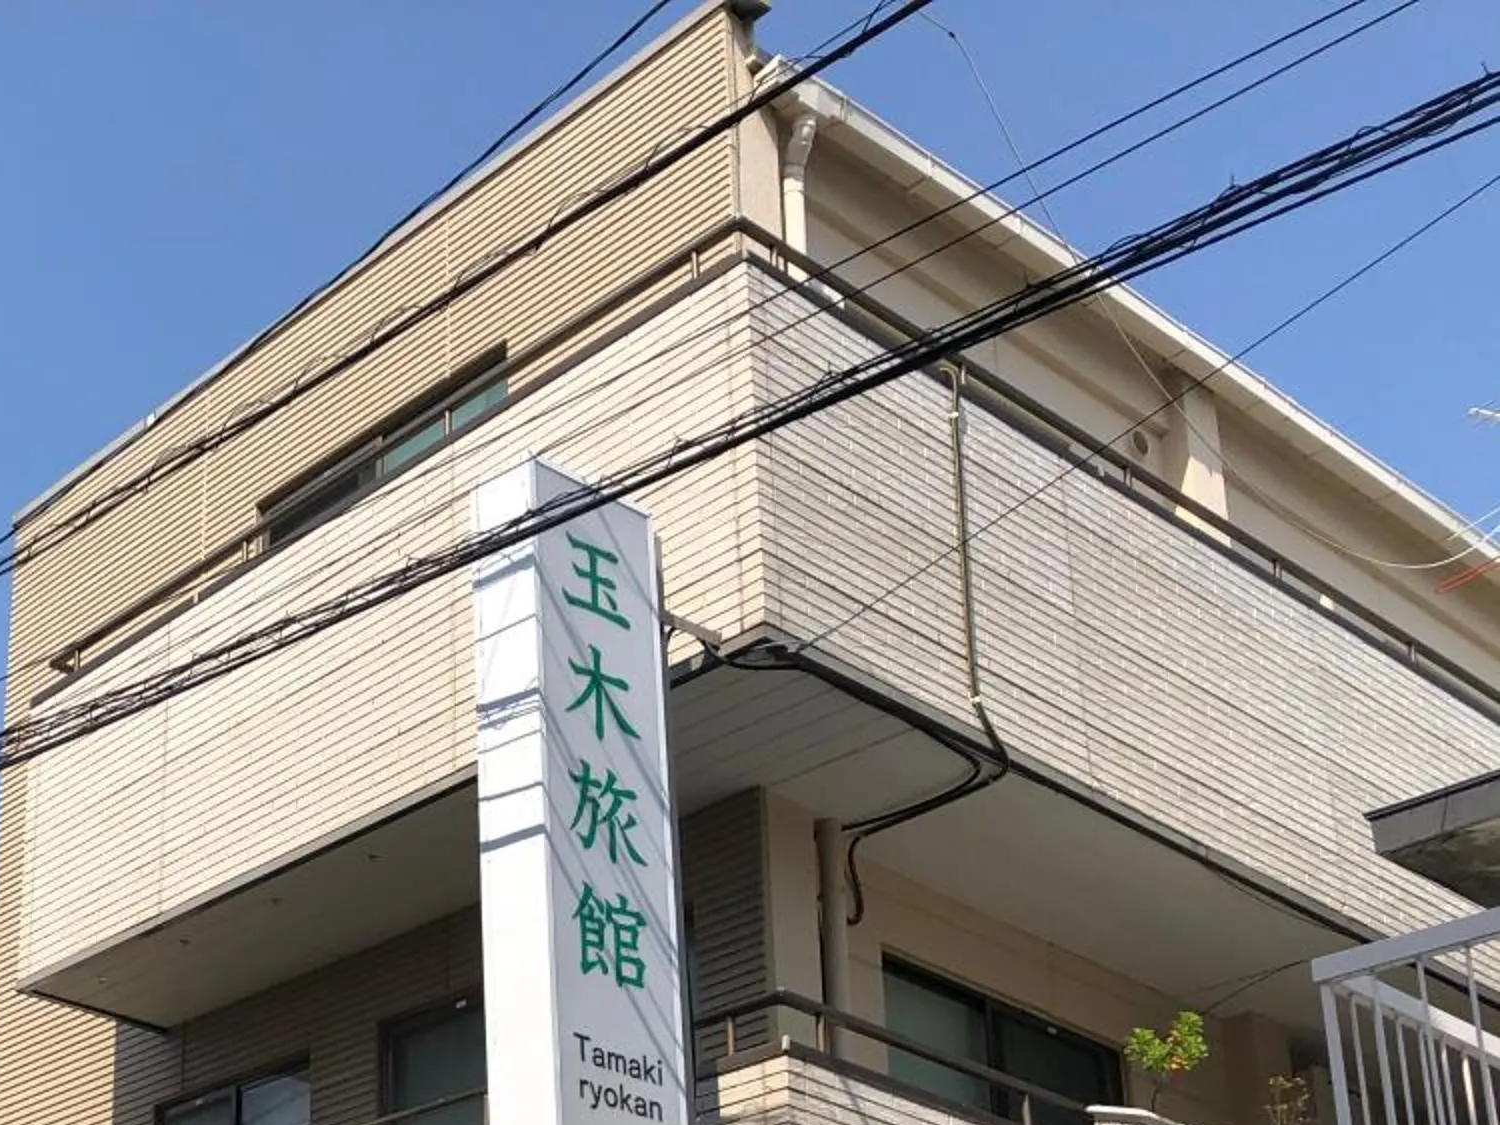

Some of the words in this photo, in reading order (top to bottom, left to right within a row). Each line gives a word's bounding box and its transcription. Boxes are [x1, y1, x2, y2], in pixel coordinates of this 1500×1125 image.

[562, 531, 649, 989] 玉木旅館
[573, 1031, 663, 1087] Tamaki
[579, 1078, 663, 1123] ryokan
